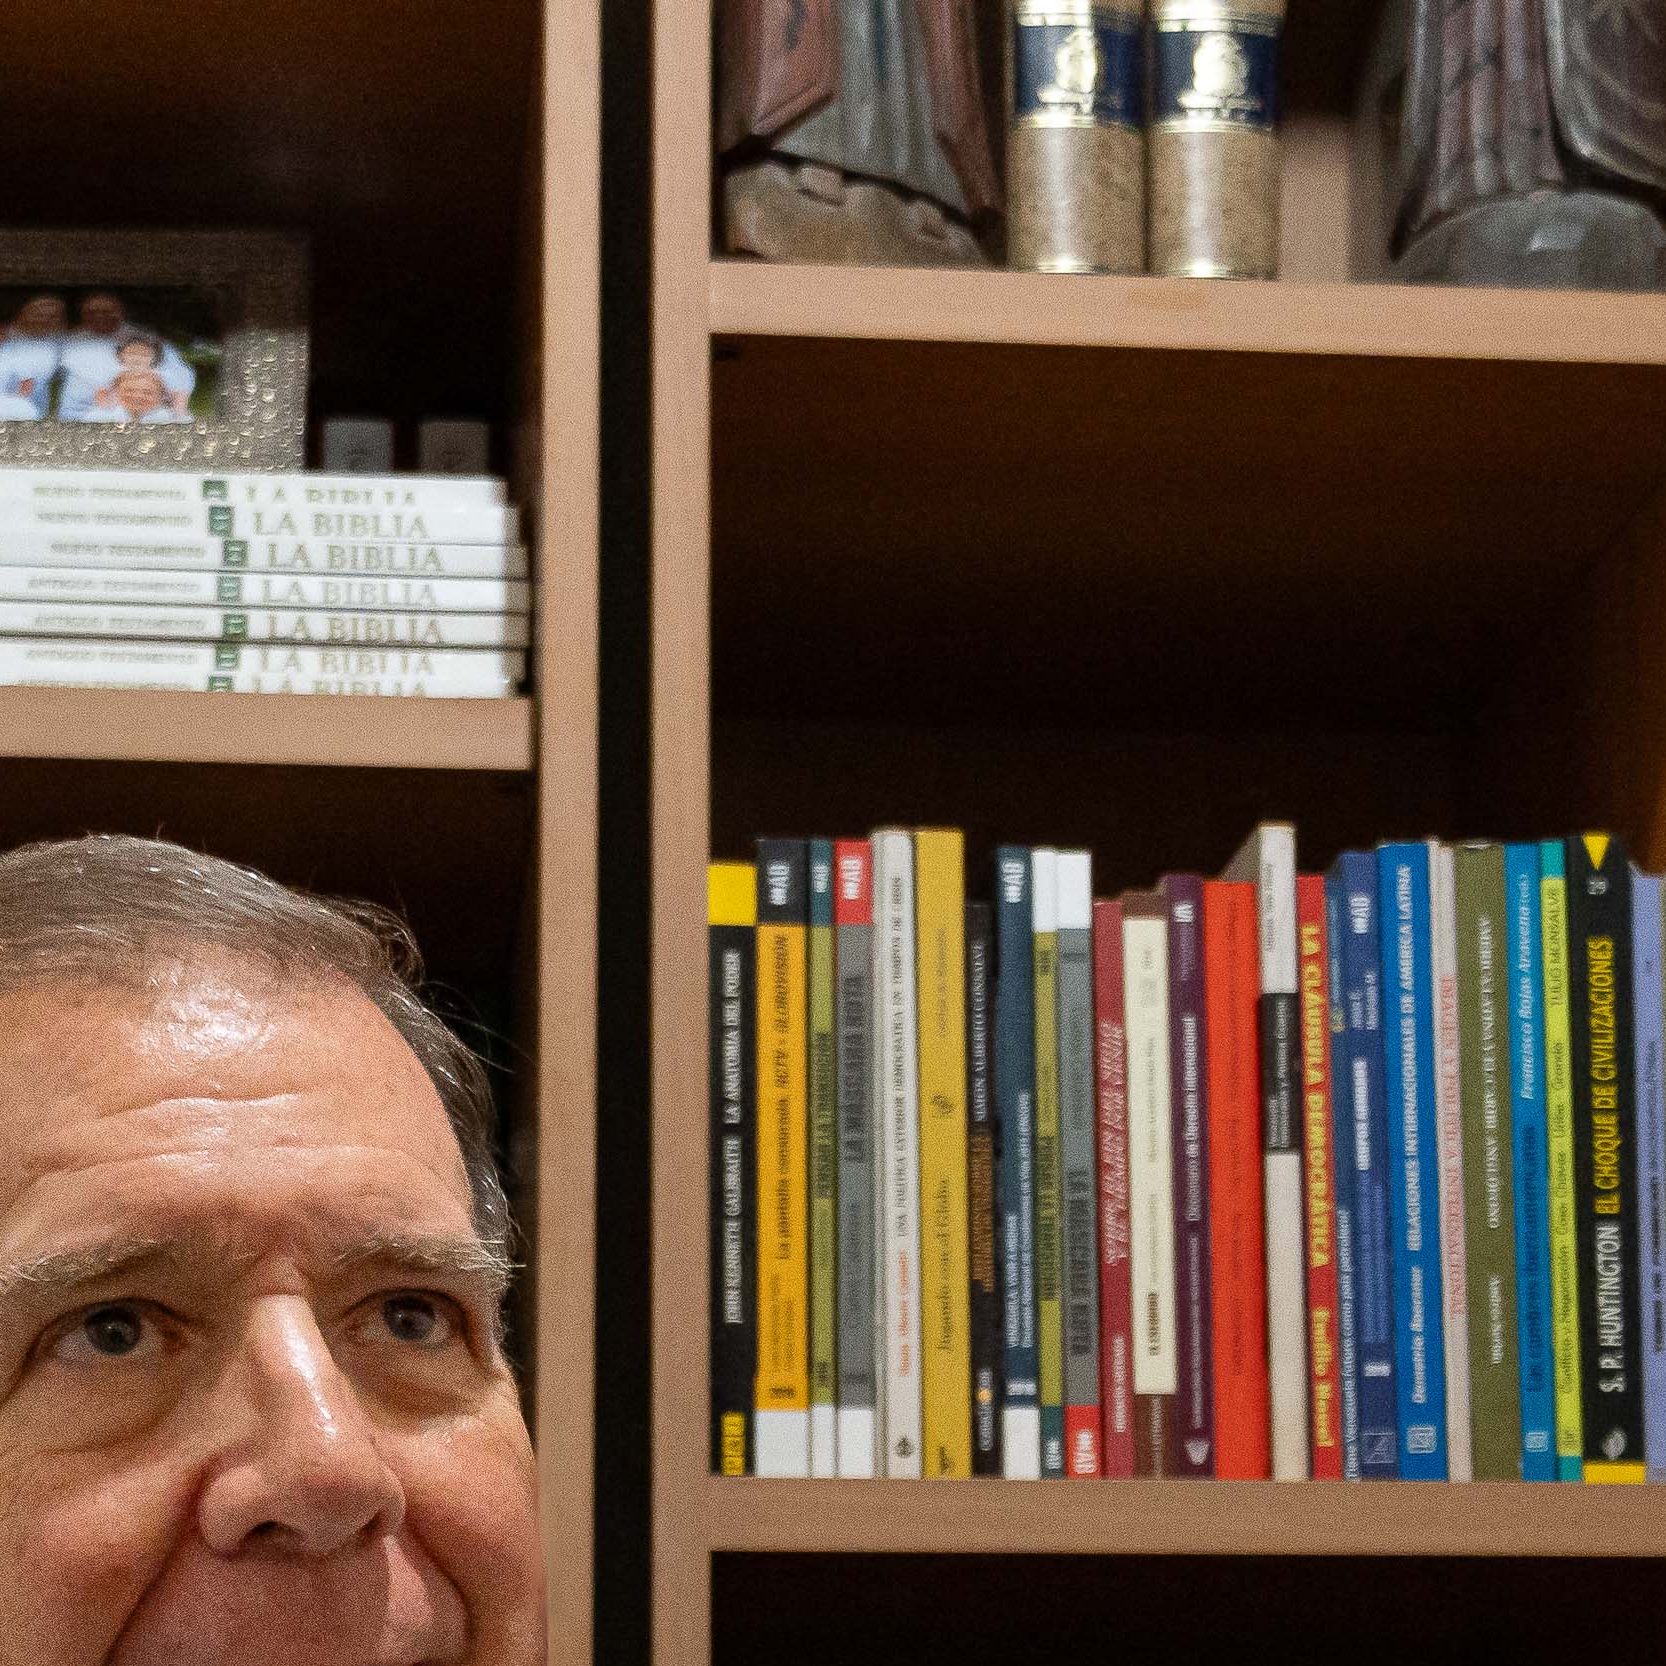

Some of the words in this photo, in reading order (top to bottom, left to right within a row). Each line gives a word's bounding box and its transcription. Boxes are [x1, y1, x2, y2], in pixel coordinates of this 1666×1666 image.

[254, 512, 297, 535] LA
[313, 514, 428, 538] BIBLIA
[267, 543, 312, 568] LA
[328, 545, 444, 572] BIBLIA
[263, 579, 307, 603] LA
[322, 581, 439, 607] BIBLIA
[269, 615, 313, 640] LA
[328, 617, 444, 644] BIBLIA
[1397, 865, 1412, 919] LATINA
[1301, 925, 1321, 956] LA
[1517, 906, 1531, 973] Aravena
[723, 952, 739, 997] PODER
[724, 1001, 740, 1027] DEL
[843, 975, 863, 1028] ROTA
[1399, 995, 1414, 1013] DE
[1519, 977, 1533, 1019] Rojas
[1587, 937, 1617, 1081] CIVILIZACIONES
[973, 1014, 986, 1072] ALBERTO
[1303, 963, 1325, 1084] CLÁUSULA
[1520, 1023, 1534, 1100] Francisco
[1400, 1018, 1417, 1157] INTERNACIONALES
[1591, 1085, 1617, 1109] DE
[724, 1106, 740, 1124] LA
[844, 1140, 863, 1164] LA
[1186, 1144, 1199, 1157] de
[1593, 1116, 1623, 1190] CHOQUE
[723, 1138, 742, 1216] GALBRAITH
[1068, 1169, 1088, 1194] LA
[1187, 1159, 1201, 1222] Diccionario
[1308, 1092, 1334, 1268] DEMOCRÁTICA
[1406, 1161, 1421, 1251] RELACIONES
[1593, 1194, 1621, 1215] EL
[723, 1220, 742, 1287] KENNETH
[776, 1243, 791, 1260] La
[1597, 1225, 1623, 1347] HUNTINGTON
[723, 1289, 744, 1324] JOHN
[1343, 1302, 1354, 1336] como
[1342, 1339, 1355, 1377] futuro
[1411, 1336, 1426, 1403] Demetrio
[1599, 1351, 1625, 1369] P.
[1599, 1376, 1626, 1393] S.
[1344, 1380, 1356, 1443] Venezuela
